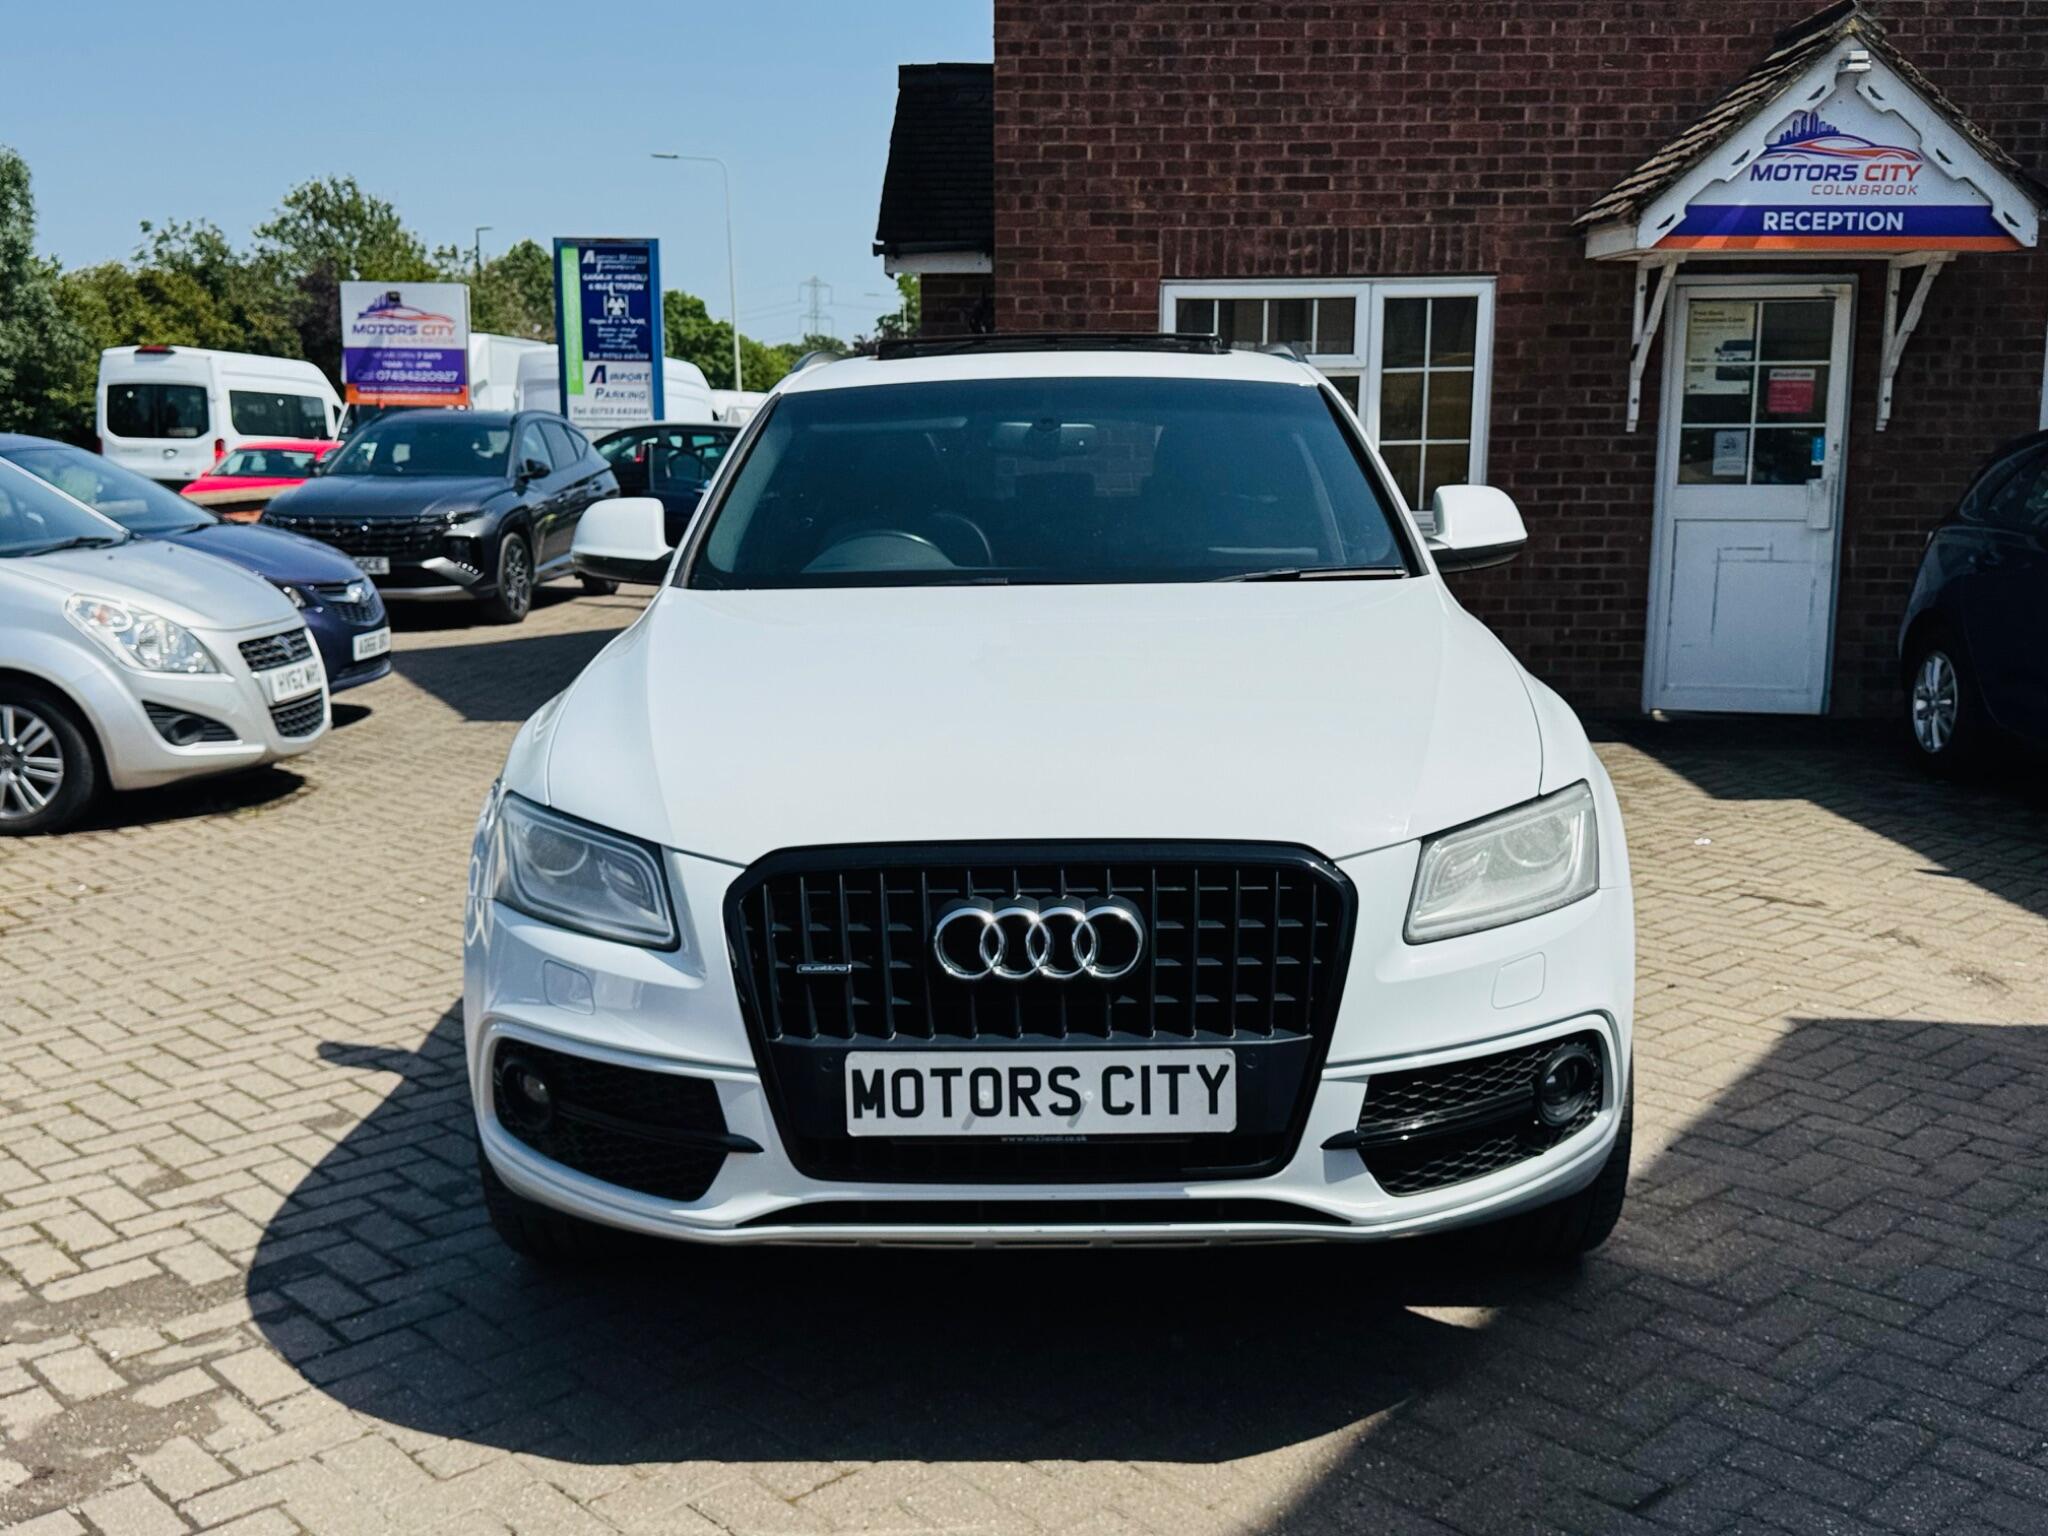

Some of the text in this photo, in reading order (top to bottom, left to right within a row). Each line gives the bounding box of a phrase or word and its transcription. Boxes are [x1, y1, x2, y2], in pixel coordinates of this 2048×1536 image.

[1750, 164, 1923, 182] MOTORS CITY
[1811, 184, 1918, 196] COLNBROOK
[1763, 211, 1904, 231] RECEPTION
[352, 324, 455, 336] MOTORS CITY
[589, 365, 650, 384] AIRPORT
[595, 387, 647, 399] PARKING
[852, 1064, 1231, 1118] MOTORS CITY
